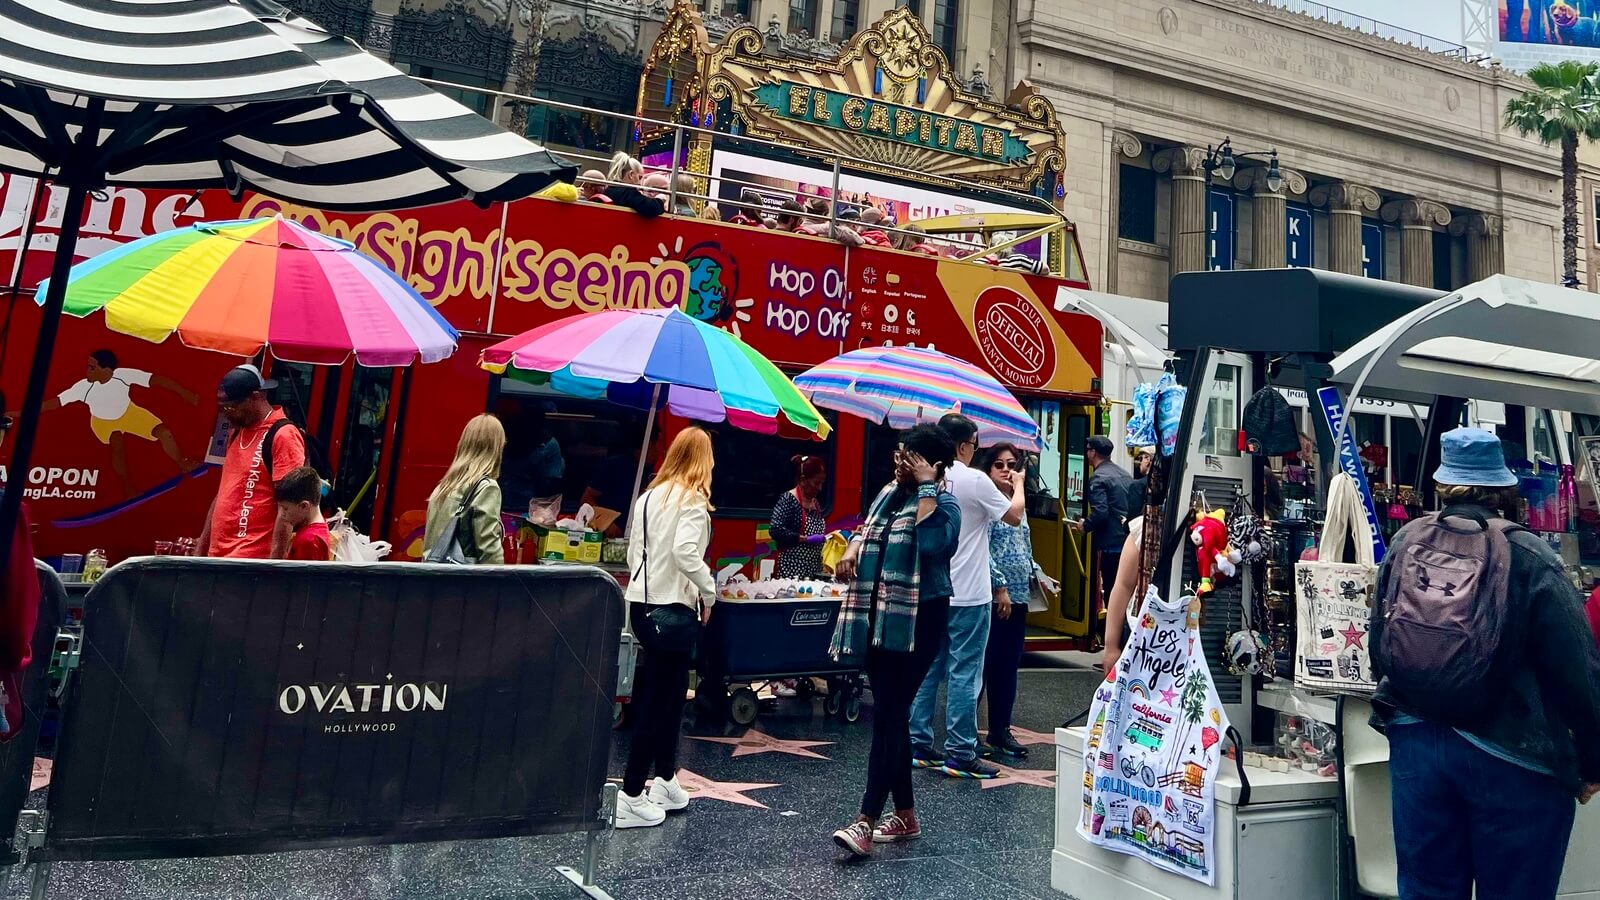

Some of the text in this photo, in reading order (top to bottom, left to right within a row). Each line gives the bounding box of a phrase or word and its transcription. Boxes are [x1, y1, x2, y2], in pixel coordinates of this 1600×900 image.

[1222, 44, 1247, 59] AND
[1259, 54, 1271, 66] IN
[789, 85, 1004, 158] EL CAPITAN
[769, 262, 815, 297] Hop
[766, 301, 852, 338] Hop Off
[1016, 297, 1042, 328] TOUR
[977, 319, 1042, 386] OF SANTA MONICA
[990, 310, 1040, 366] OFFICIAL
[23, 486, 96, 500] ngLA.com
[244, 469, 261, 500] Klein
[237, 499, 254, 538] Jeans
[1315, 600, 1369, 620] HOLLYWO
[1150, 624, 1180, 654] Los
[1132, 637, 1187, 691] Angeles
[279, 672, 448, 715] OVATION
[324, 722, 396, 734] HOLLYWOOD
[1131, 702, 1172, 725] california
[1095, 775, 1163, 809] HOLLYWOOD
